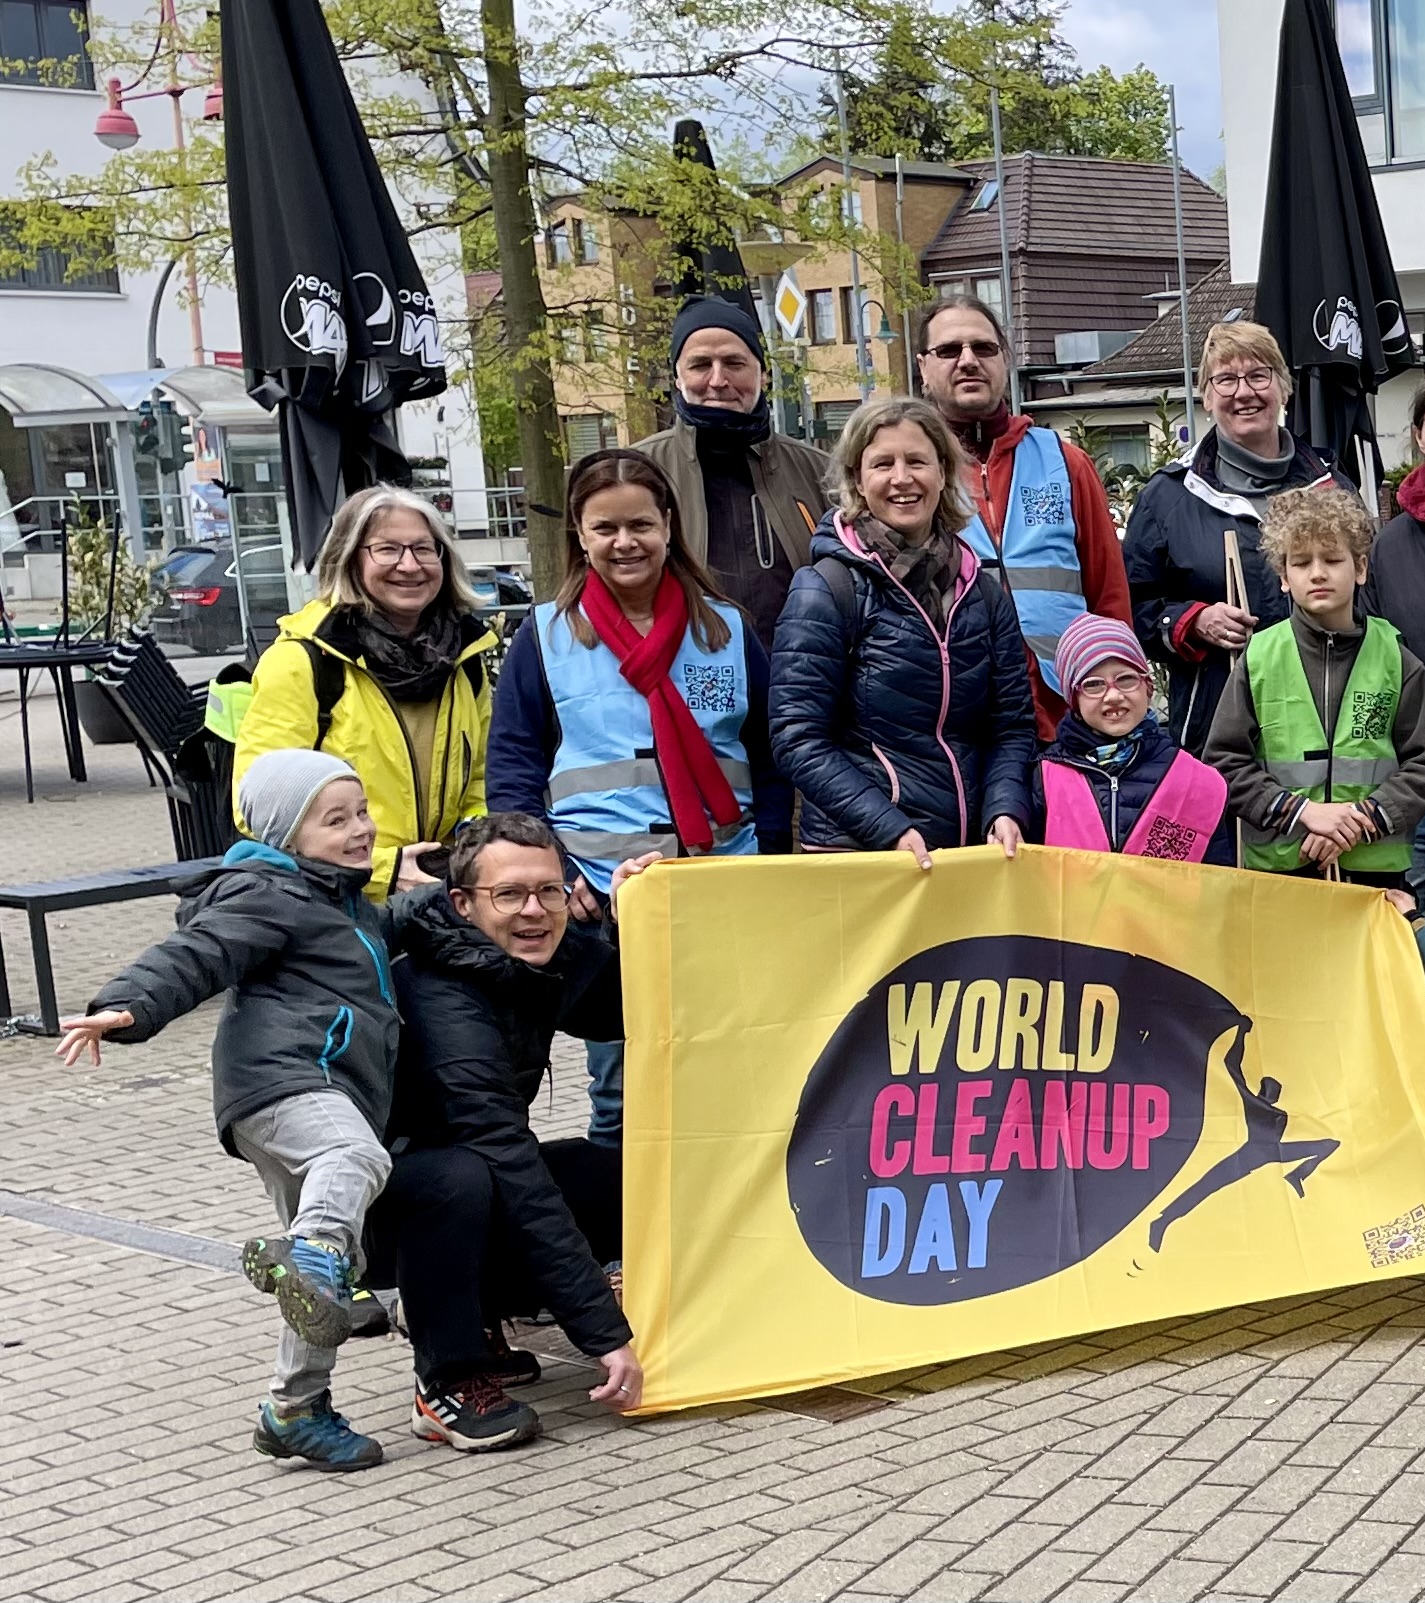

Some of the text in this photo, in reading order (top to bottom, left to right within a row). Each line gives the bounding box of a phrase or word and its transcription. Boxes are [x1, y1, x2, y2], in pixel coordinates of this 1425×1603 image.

[887, 978, 1120, 1076] WORLD
[869, 1078, 1170, 1178] CLEANUP
[861, 1179, 1004, 1278] DAY
